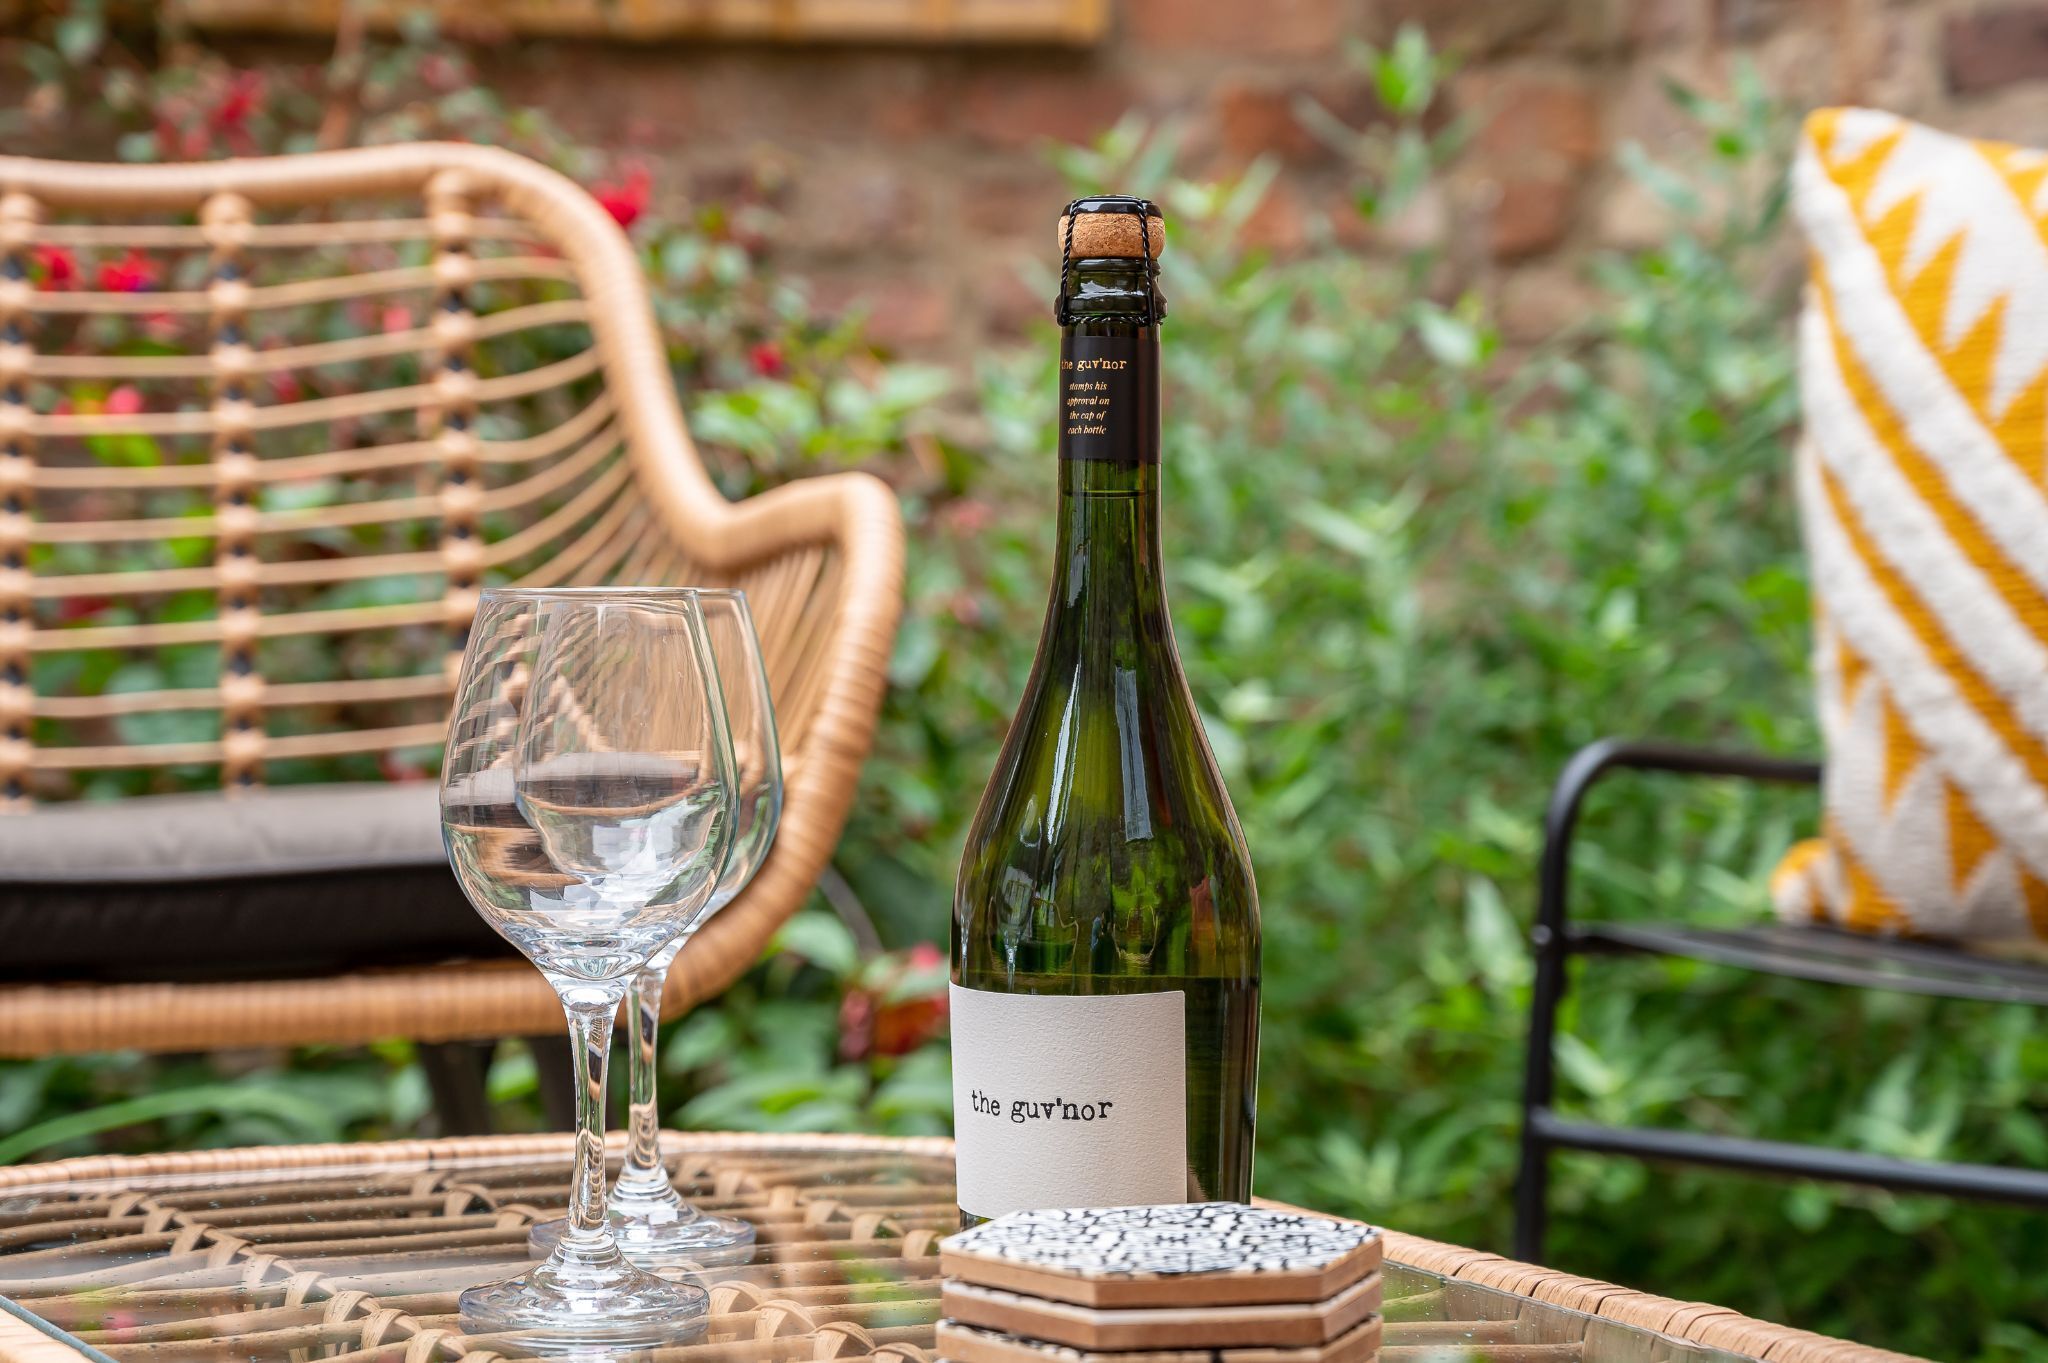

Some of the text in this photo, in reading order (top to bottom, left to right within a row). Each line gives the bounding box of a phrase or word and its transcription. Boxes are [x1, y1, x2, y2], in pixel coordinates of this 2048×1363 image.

[1077, 358, 1127, 371] guv'nor
[1068, 381, 1107, 391] stamps his
[1067, 396, 1098, 406] approval
[1069, 411, 1107, 421] the cap of
[1068, 425, 1107, 434] each bottle
[972, 1090, 1113, 1123] the guv'nor
